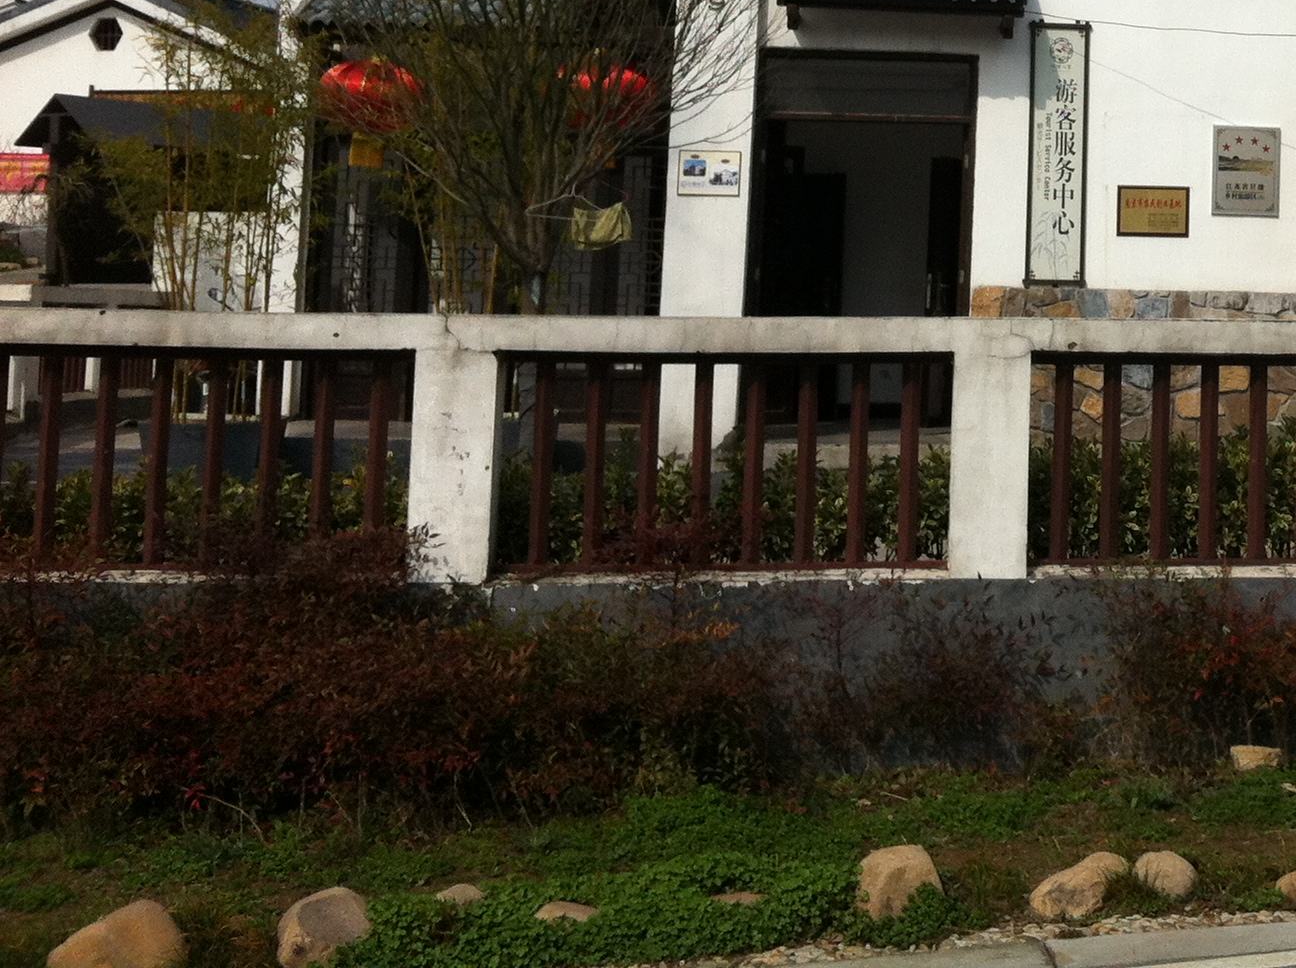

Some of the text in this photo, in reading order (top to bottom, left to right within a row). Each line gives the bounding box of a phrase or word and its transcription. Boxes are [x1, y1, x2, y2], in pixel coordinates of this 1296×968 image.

[1045, 112, 1053, 140] Tourist
[1044, 144, 1052, 173] Service
[1052, 78, 1078, 236] 游客服务中心
